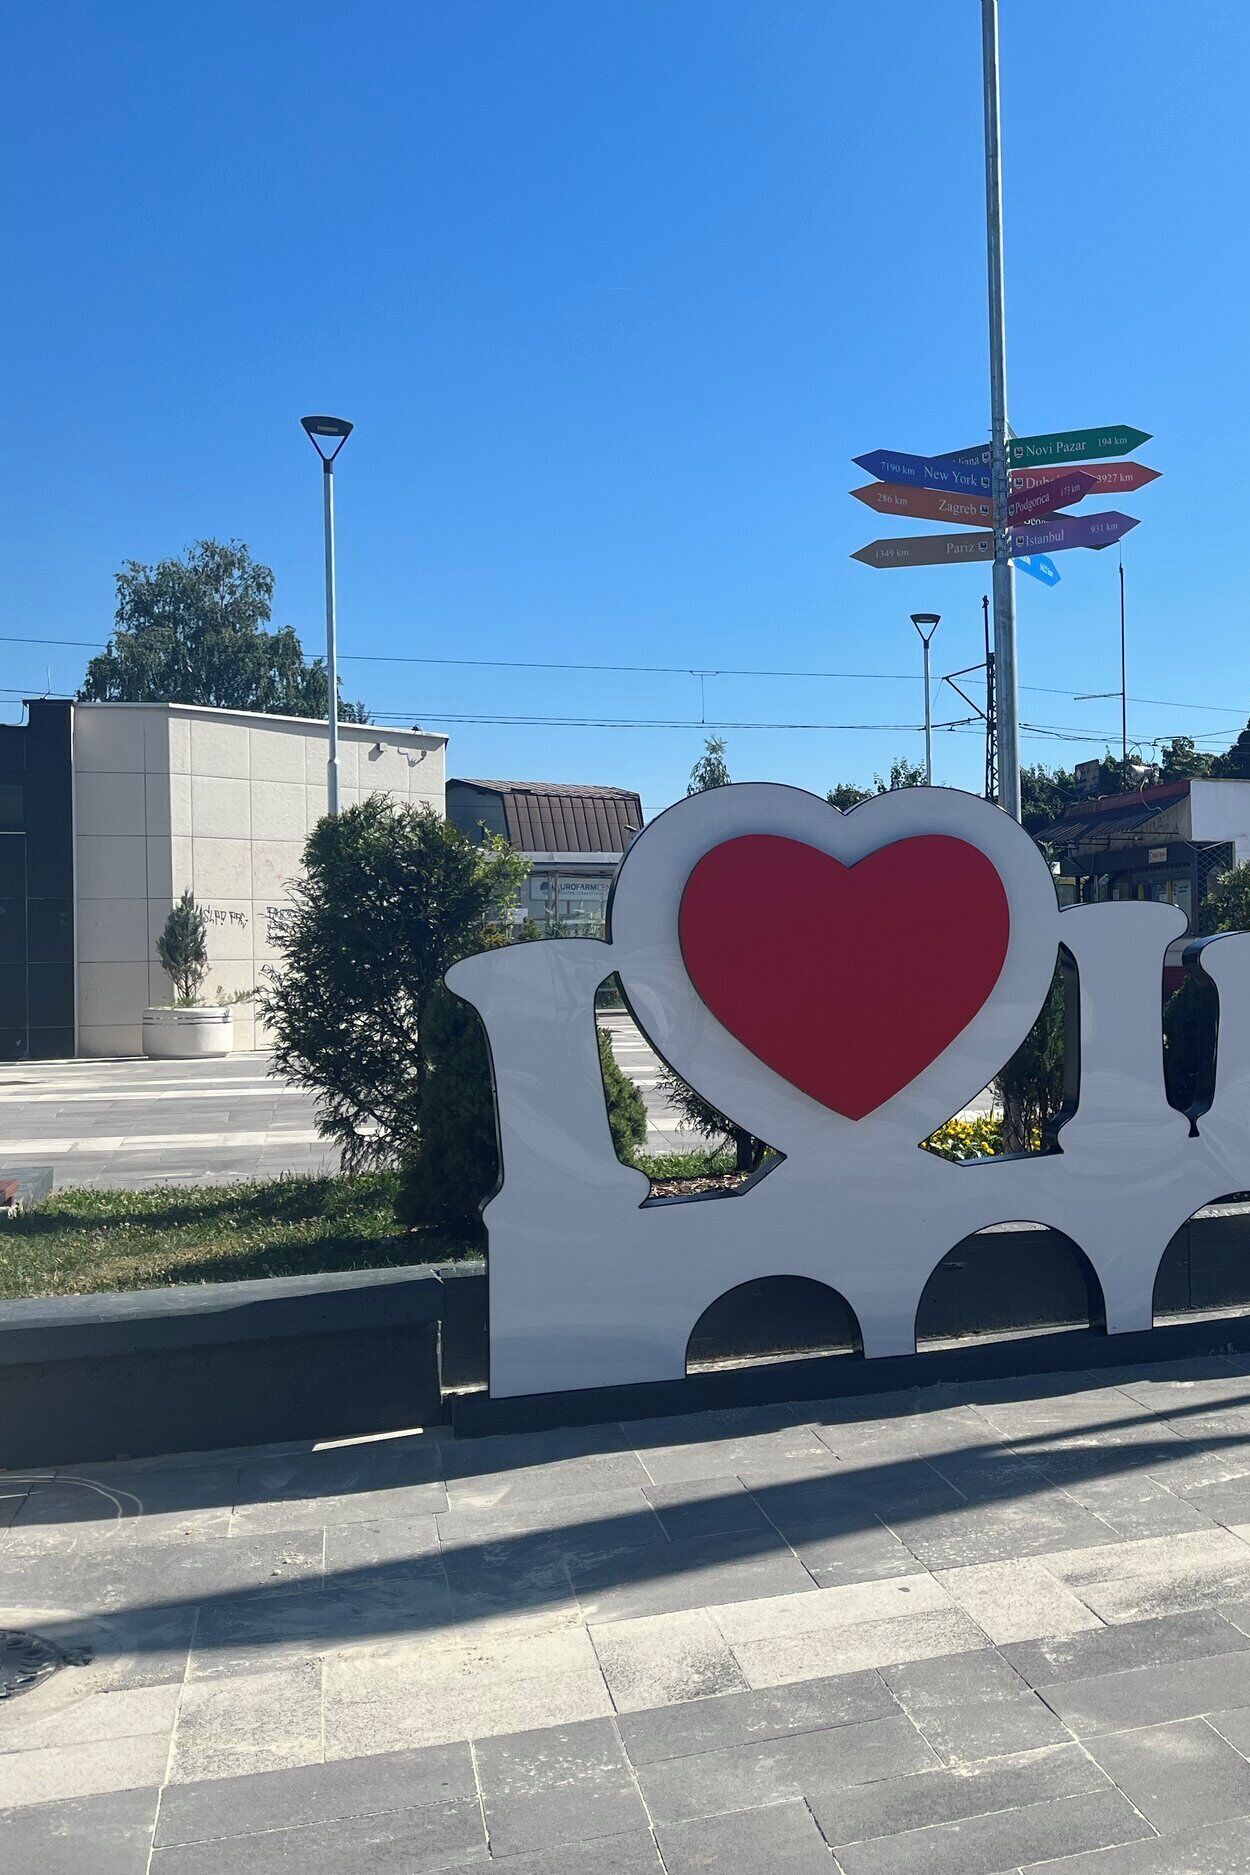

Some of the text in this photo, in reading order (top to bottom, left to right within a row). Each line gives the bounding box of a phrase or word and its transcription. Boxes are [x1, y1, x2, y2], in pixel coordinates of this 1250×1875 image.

[1025, 436, 1128, 456] Novi Pazar 194 km
[880, 461, 978, 486] 7190 km New York
[1119, 472, 1134, 482] km
[878, 493, 977, 516] 286 km Zagreb
[1015, 484, 1081, 514] Podgorica 173 km
[1025, 522, 1118, 546] Istanbul 931 km
[875, 542, 975, 559] 1349 km Pariz
